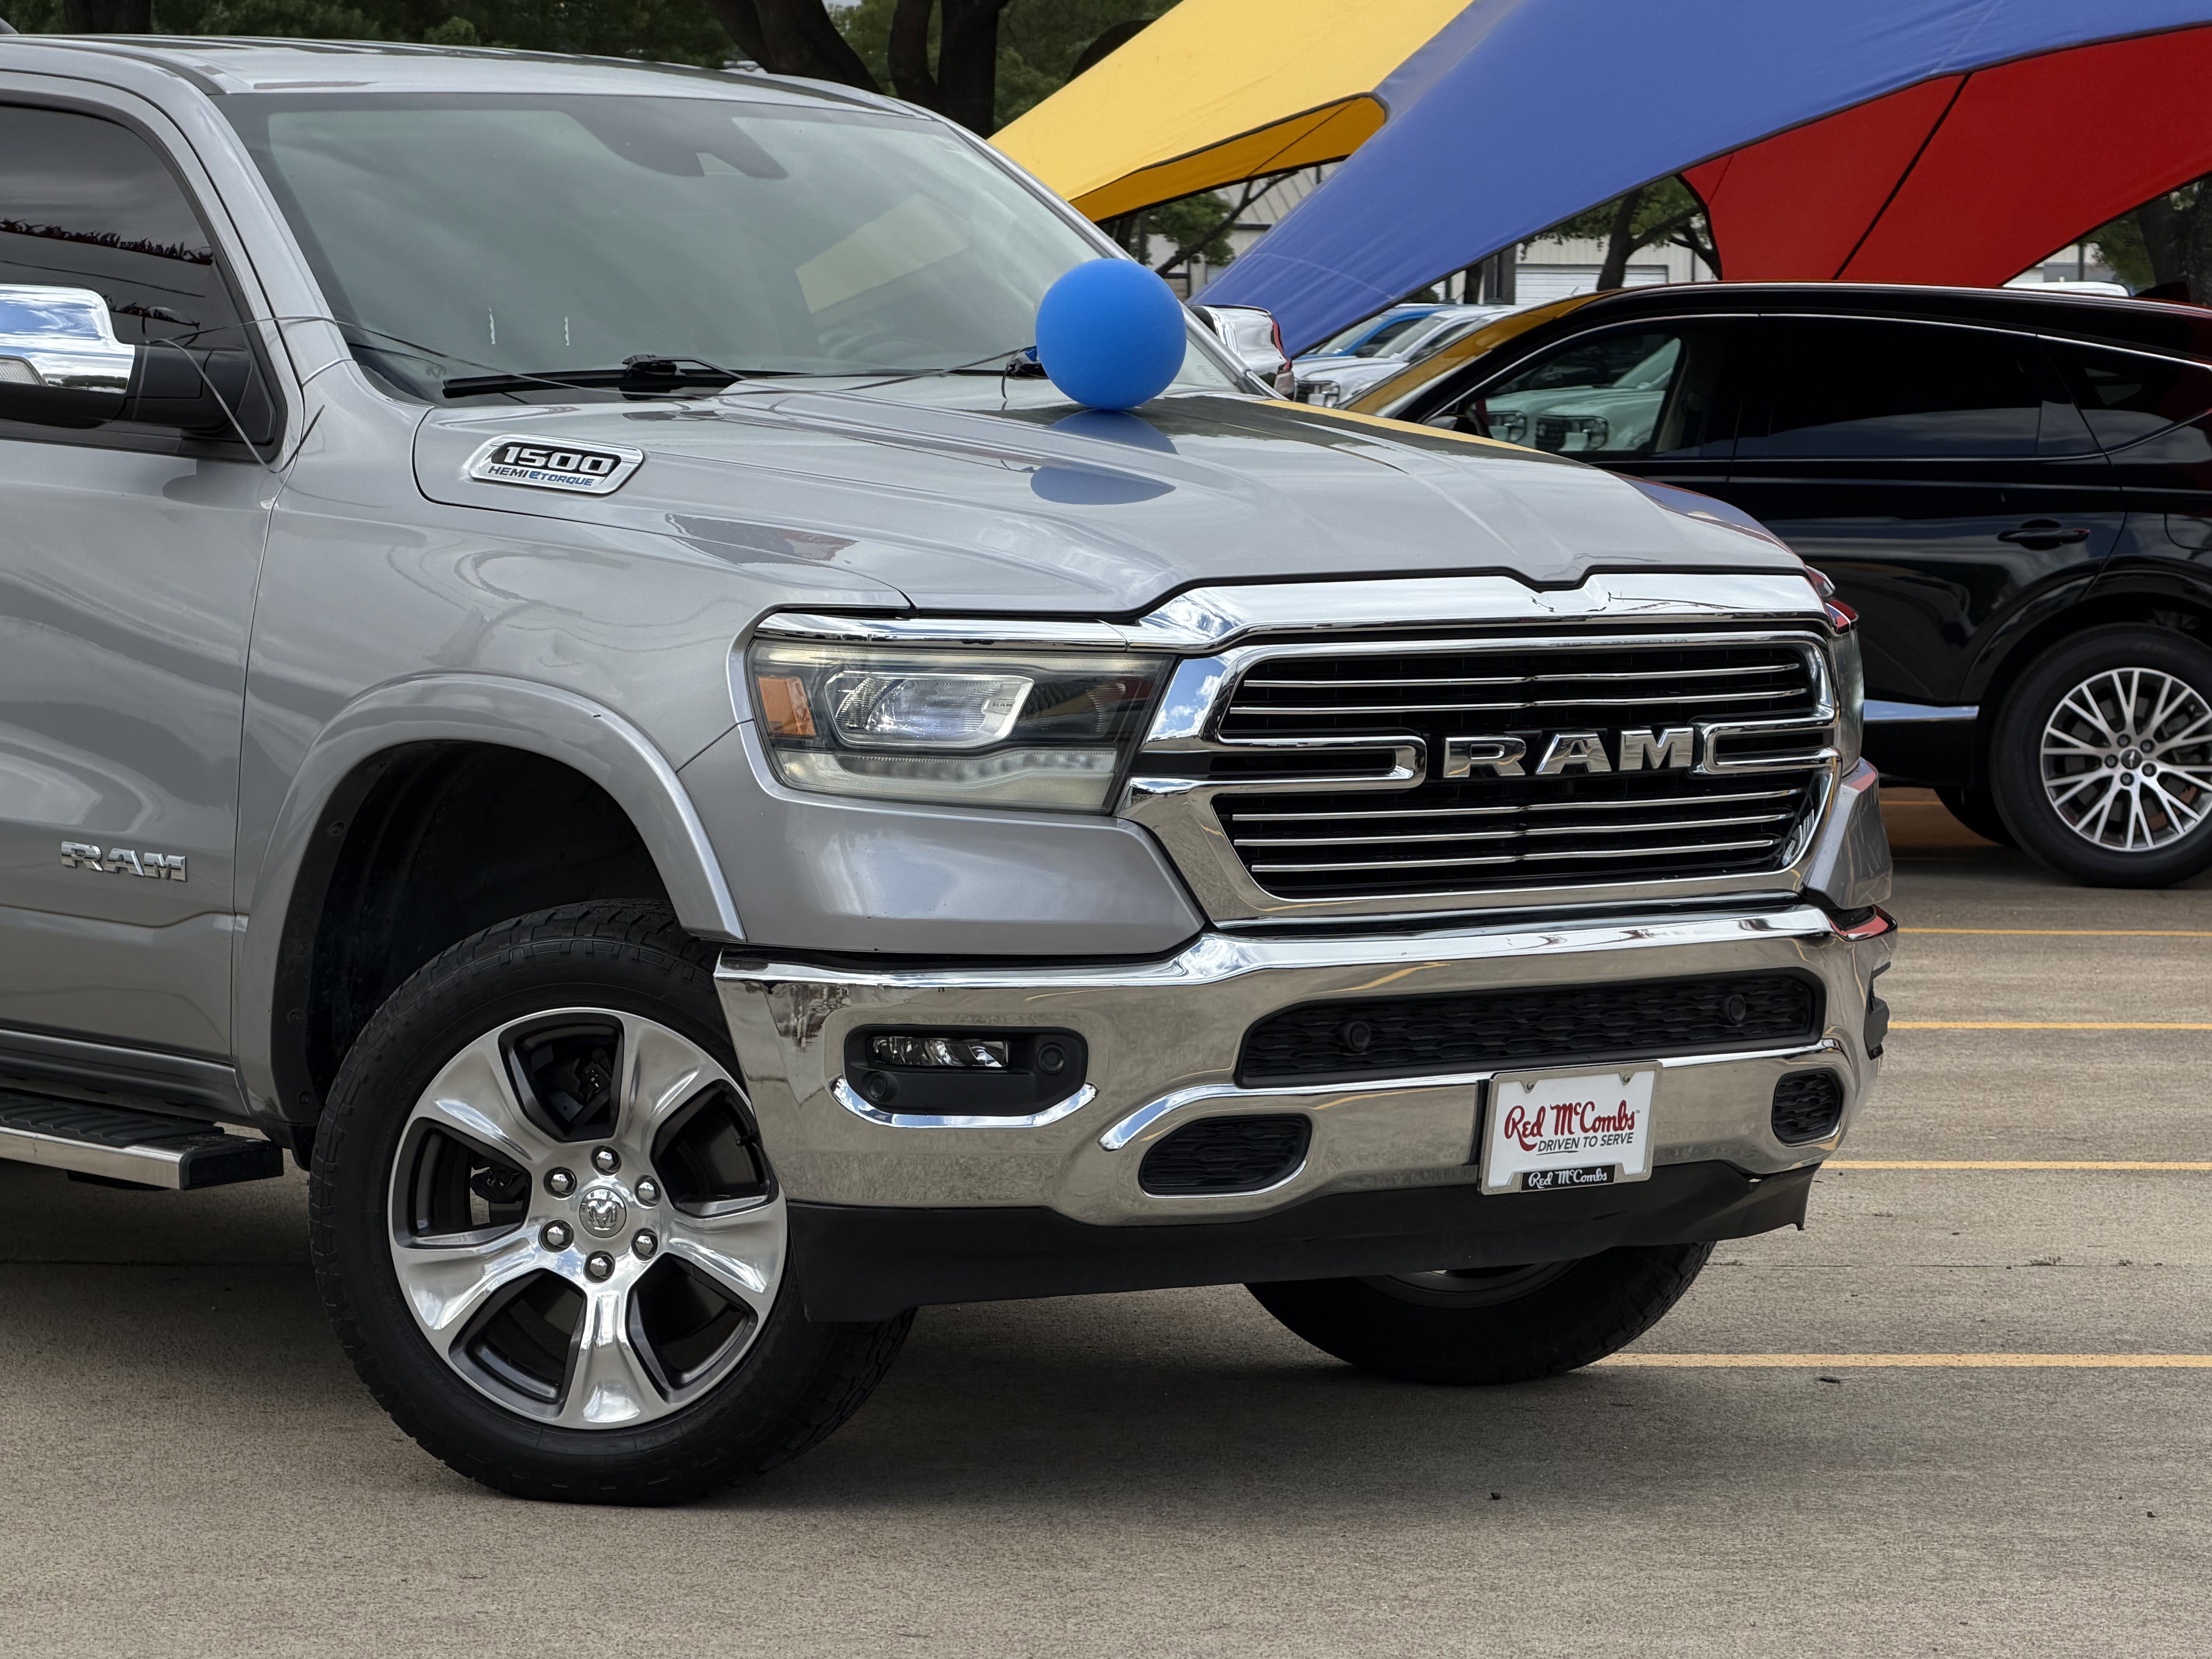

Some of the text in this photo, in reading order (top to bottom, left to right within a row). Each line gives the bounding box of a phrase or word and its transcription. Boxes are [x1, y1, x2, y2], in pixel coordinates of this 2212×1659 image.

[487, 466, 529, 478] HEMI
[504, 447, 614, 474] 1500
[1443, 727, 1694, 778] RAM
[61, 841, 187, 882] RAM
[1504, 1099, 1635, 1152] Red McCombs
[1537, 1132, 1634, 1152] DRIVEN TO SERVE
[1528, 1168, 1607, 1189] Red McCombs
